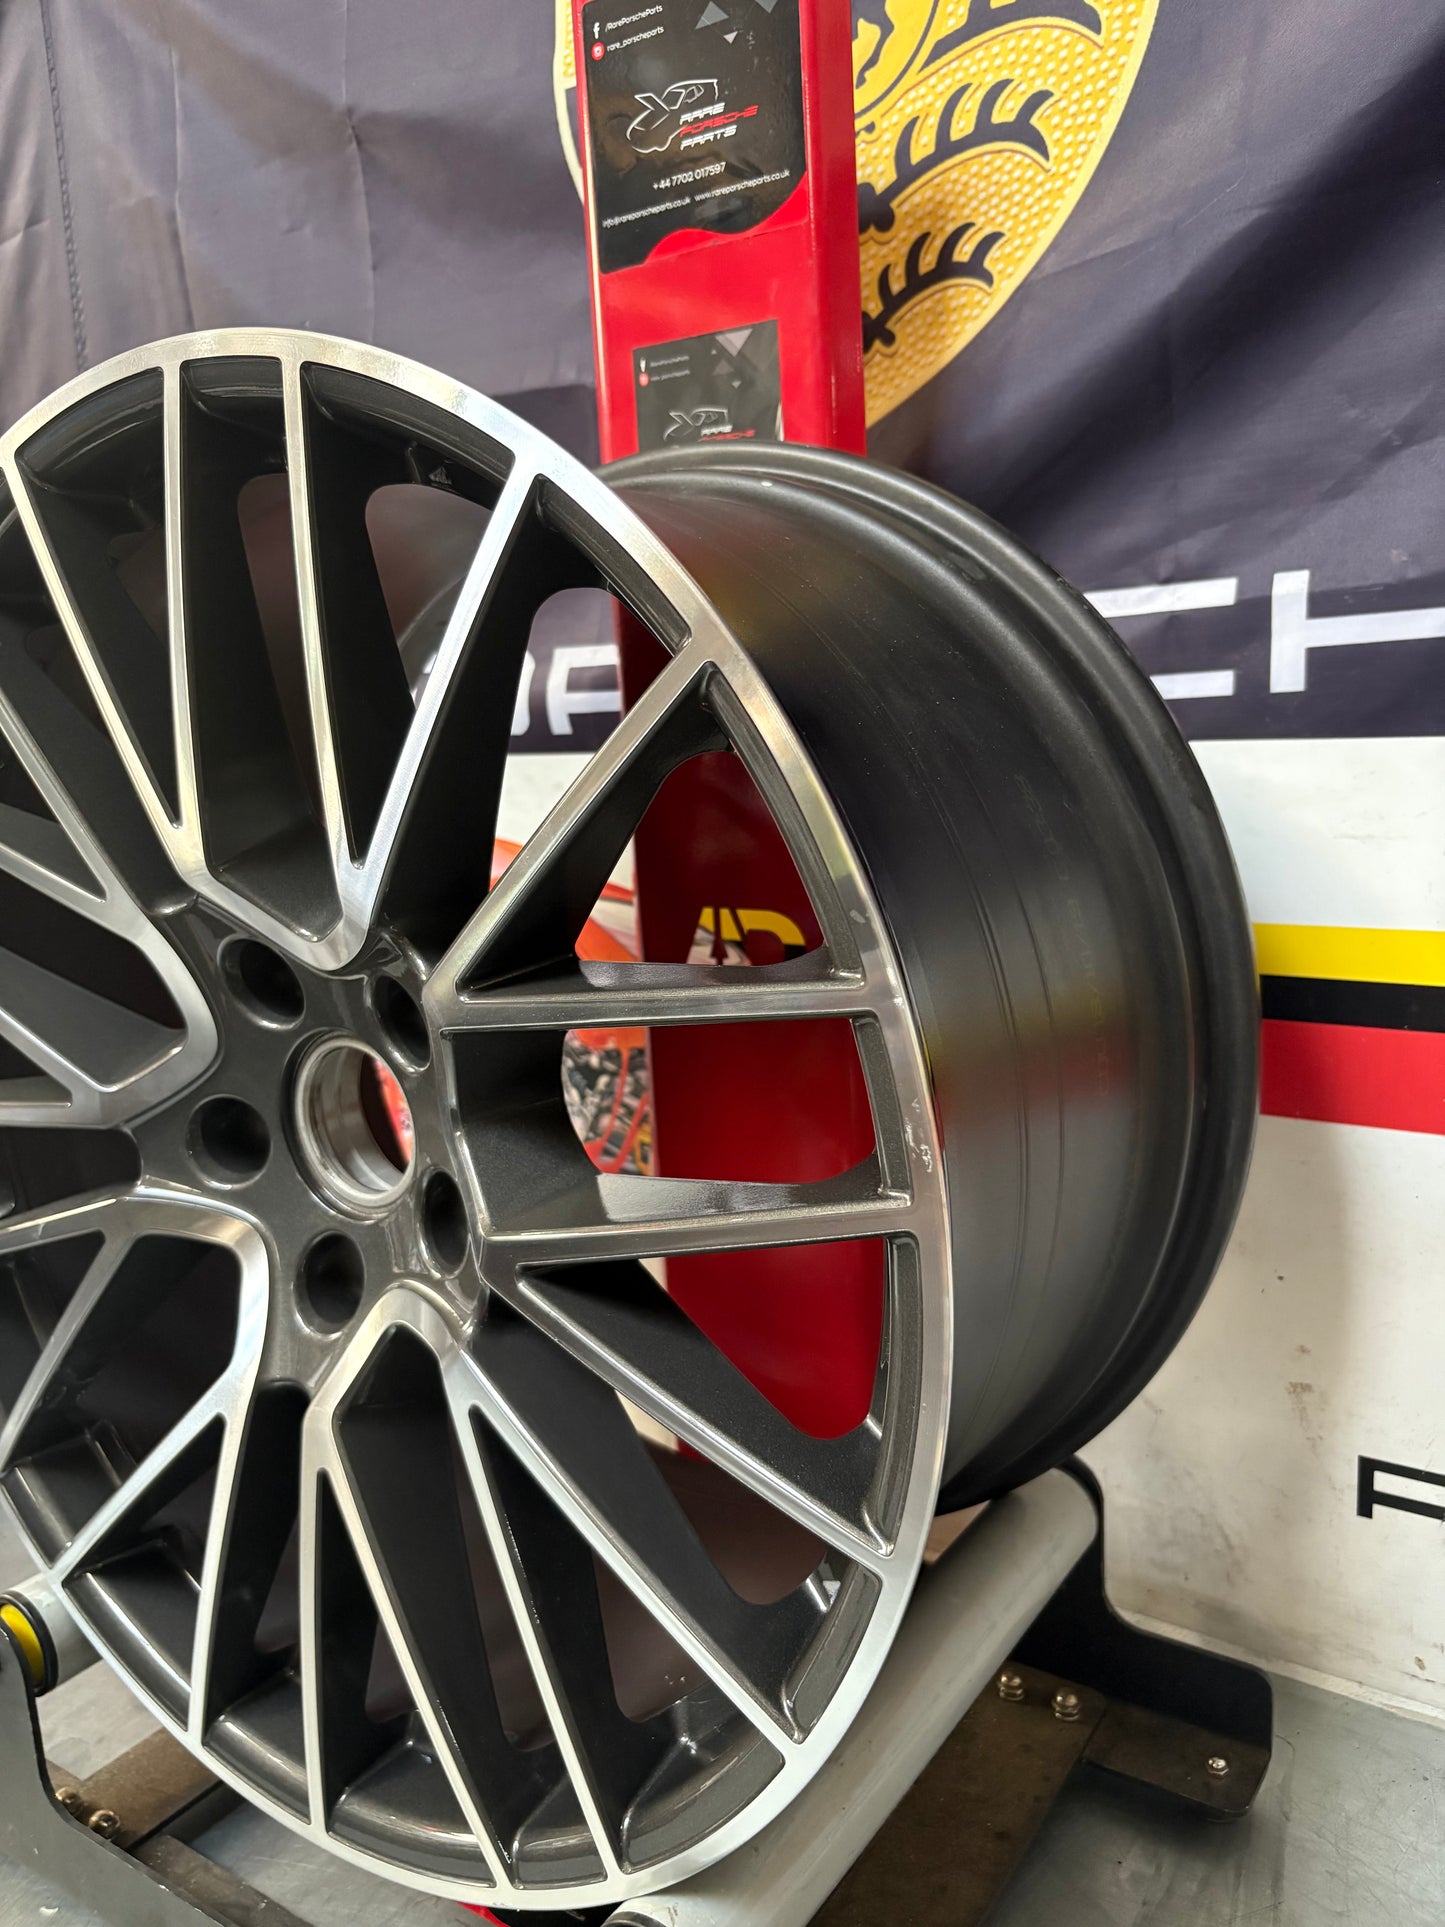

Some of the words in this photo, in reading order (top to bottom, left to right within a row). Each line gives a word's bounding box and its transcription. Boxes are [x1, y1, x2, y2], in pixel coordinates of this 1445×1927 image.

[607, 26, 665, 52] rare_porscheparts
[679, 101, 726, 125] RARE
[679, 104, 759, 138] PORSCHE
[679, 125, 737, 151] PARTS
[653, 179, 671, 190] +44
[672, 172, 693, 187] 7702
[694, 161, 727, 181] 017597
